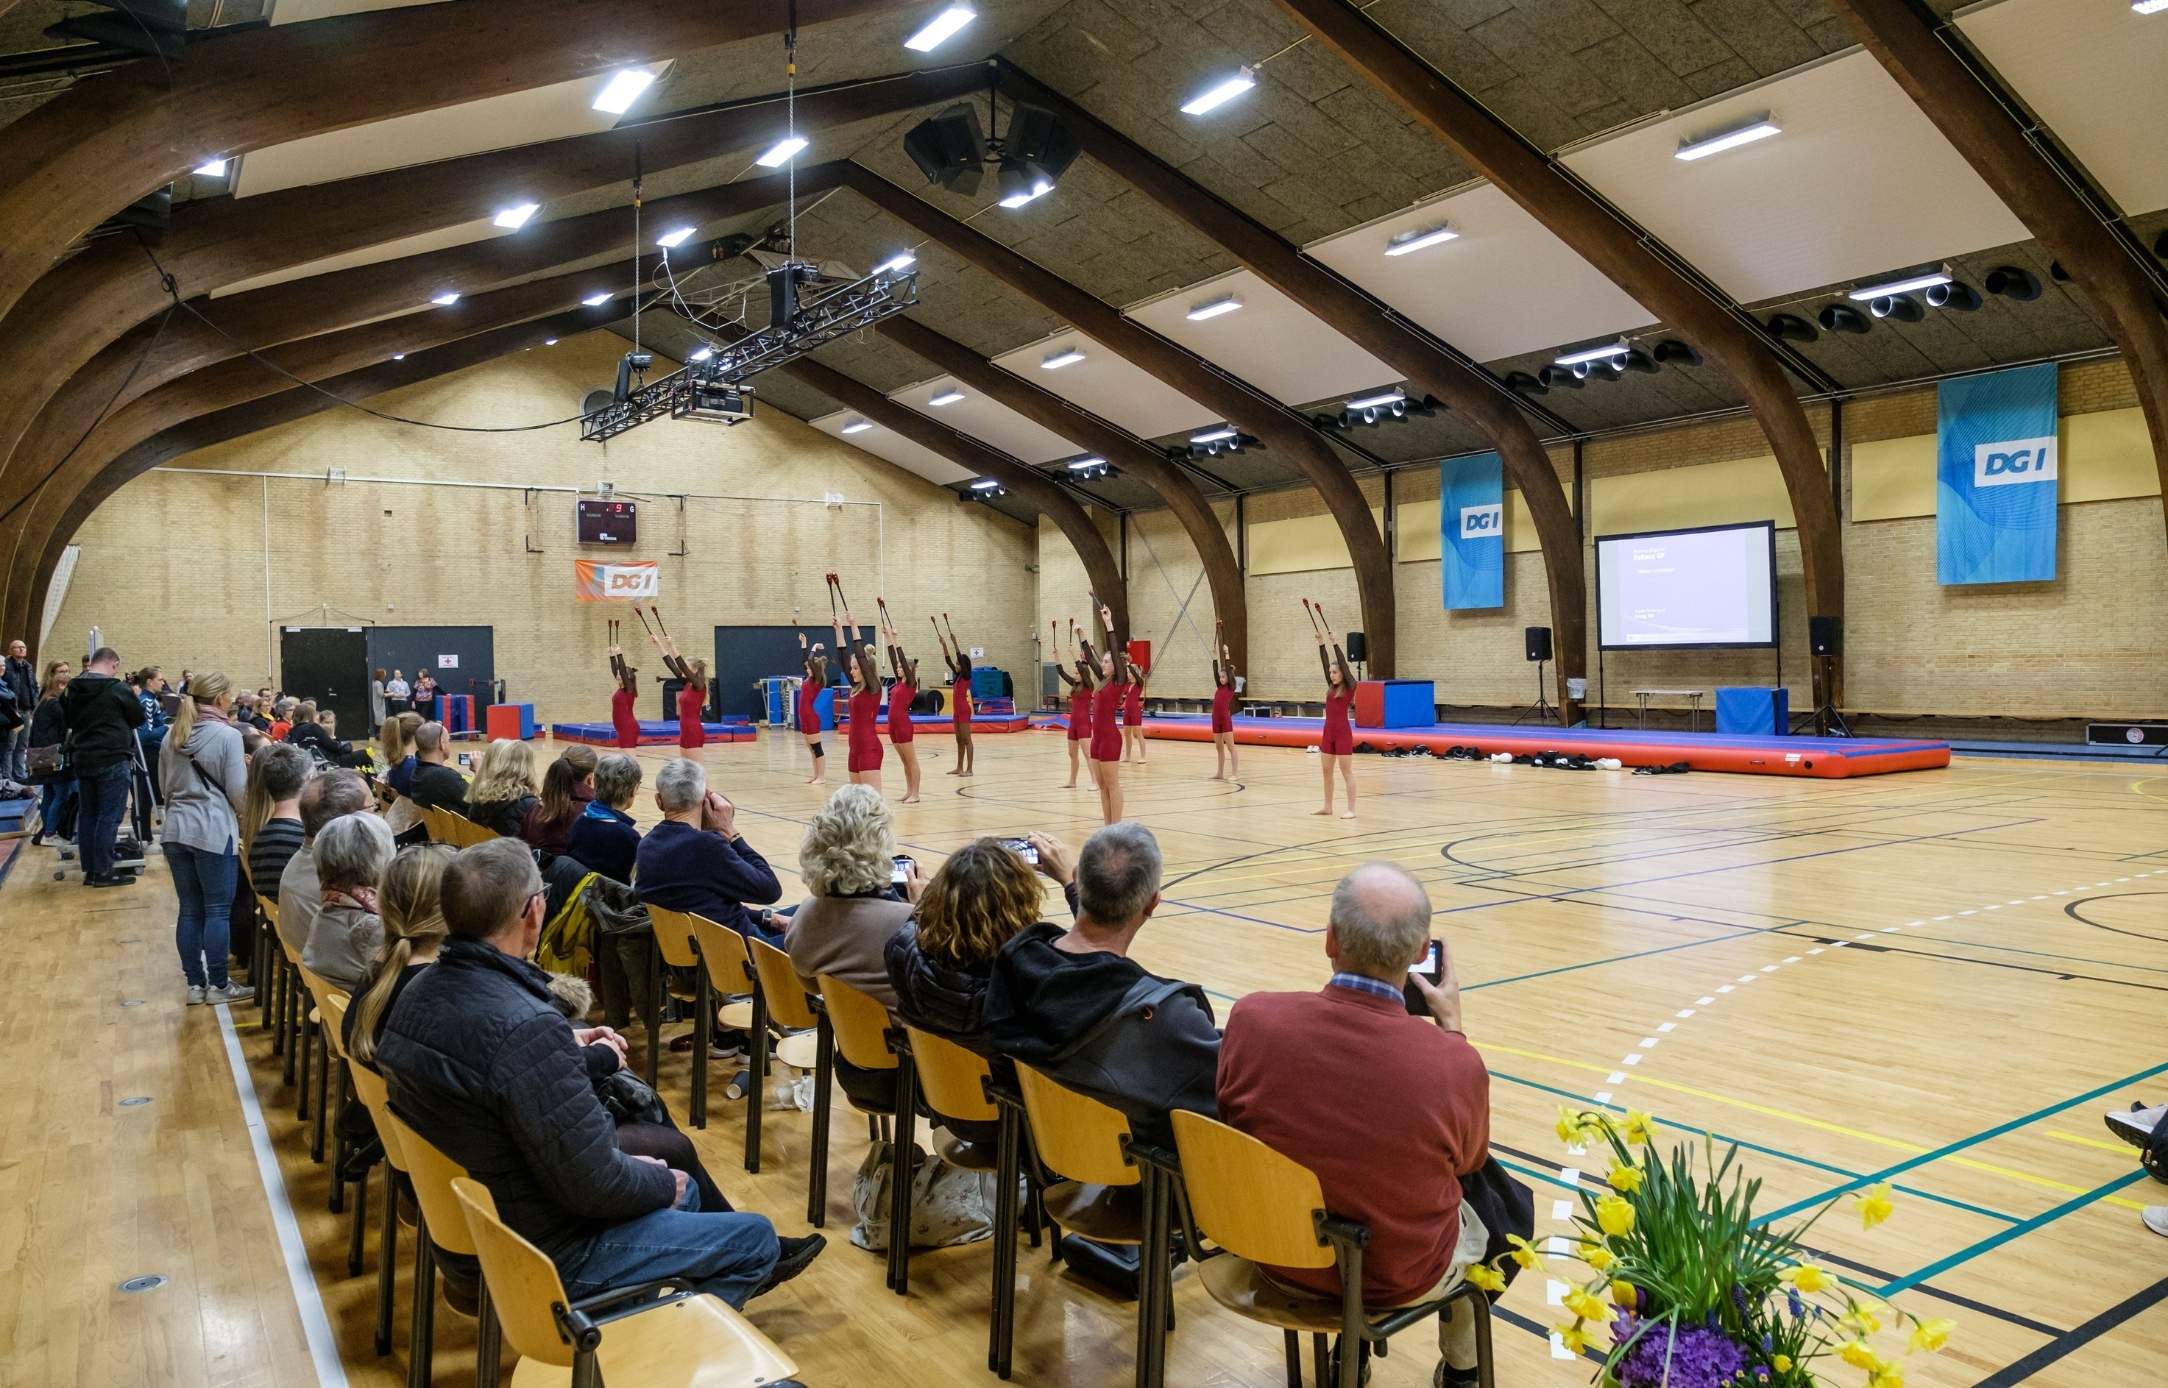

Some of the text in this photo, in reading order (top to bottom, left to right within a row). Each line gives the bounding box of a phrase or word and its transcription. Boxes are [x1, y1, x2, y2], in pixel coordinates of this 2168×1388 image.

[1984, 448, 2047, 476] DGI
[1466, 511, 1499, 531] DGI
[611, 574, 652, 590] DGI
